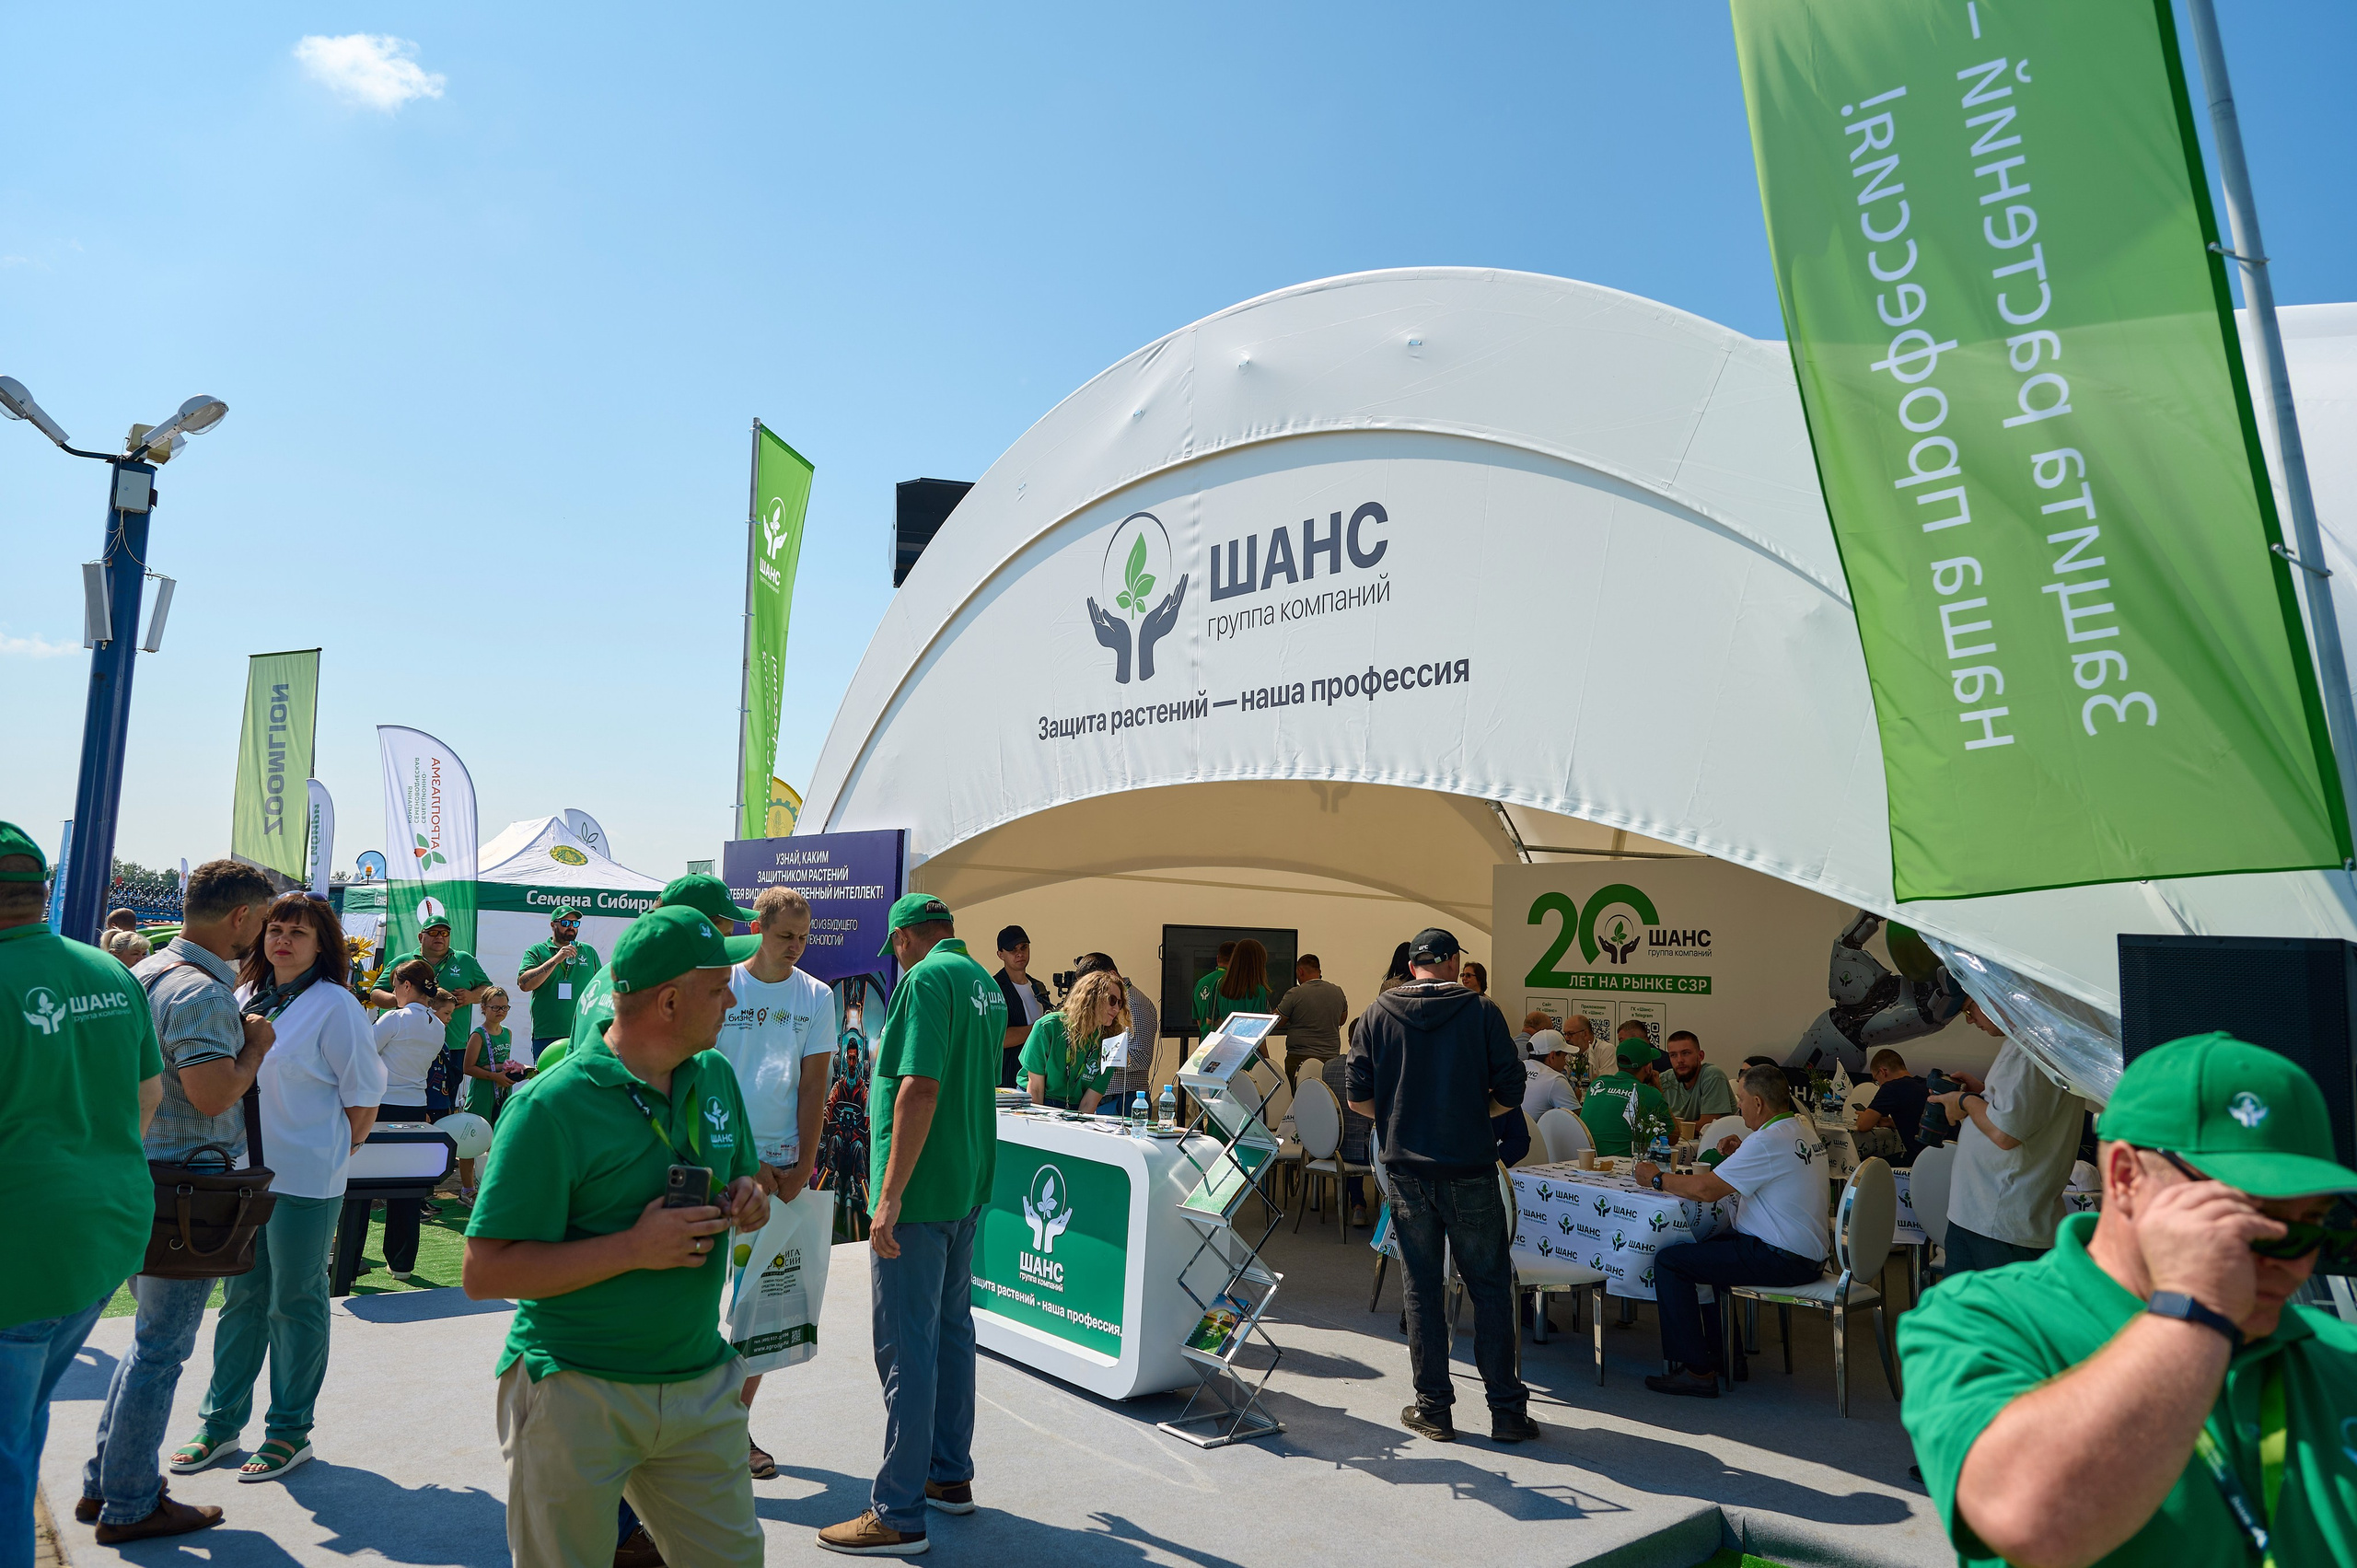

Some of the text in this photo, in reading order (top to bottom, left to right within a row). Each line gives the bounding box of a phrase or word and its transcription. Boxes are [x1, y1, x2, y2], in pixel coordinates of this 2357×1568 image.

[1210, 502, 1389, 602] ШАНС
[760, 557, 781, 587] ШАНС
[1207, 573, 1391, 640] группа компаний
[1038, 714, 1107, 740] Защита
[1110, 690, 1209, 734] растений
[1241, 680, 1305, 711] наша
[1311, 657, 1471, 705] профессия
[775, 850, 829, 866] УЗНАЙ, КАКИМ
[757, 865, 849, 884] ЗАЩИТНИКОМ РАСТЕНИЙ
[526, 889, 592, 908] Семена
[833, 885, 884, 899] ИНТЕЛЛЕКТ!
[827, 919, 858, 932] БУДУЩЕГО
[1525, 883, 1661, 987] 20
[1648, 929, 1712, 947] ШАНС
[1647, 948, 1713, 958] группа компаний
[1569, 974, 1707, 992] ЛЕТ НА РЫНКЕ СЗР
[69, 992, 129, 1013] ШАНС
[710, 1133, 734, 1144] ШАНС
[1555, 1190, 1580, 1202] ШАНС
[1523, 1208, 1547, 1222] ШАНС
[1613, 1204, 1637, 1219] ШАНС
[1576, 1223, 1601, 1237] ШАНС
[1673, 1220, 1689, 1228] ША
[1555, 1246, 1578, 1260] ШАНС
[1628, 1239, 1656, 1252] ШАНС
[1019, 1250, 1064, 1283] ШАНС
[1019, 1272, 1063, 1294] группа компаний
[997, 1283, 1036, 1307] растений
[1042, 1300, 1065, 1317] наша
[1067, 1308, 1123, 1337] профессия.
